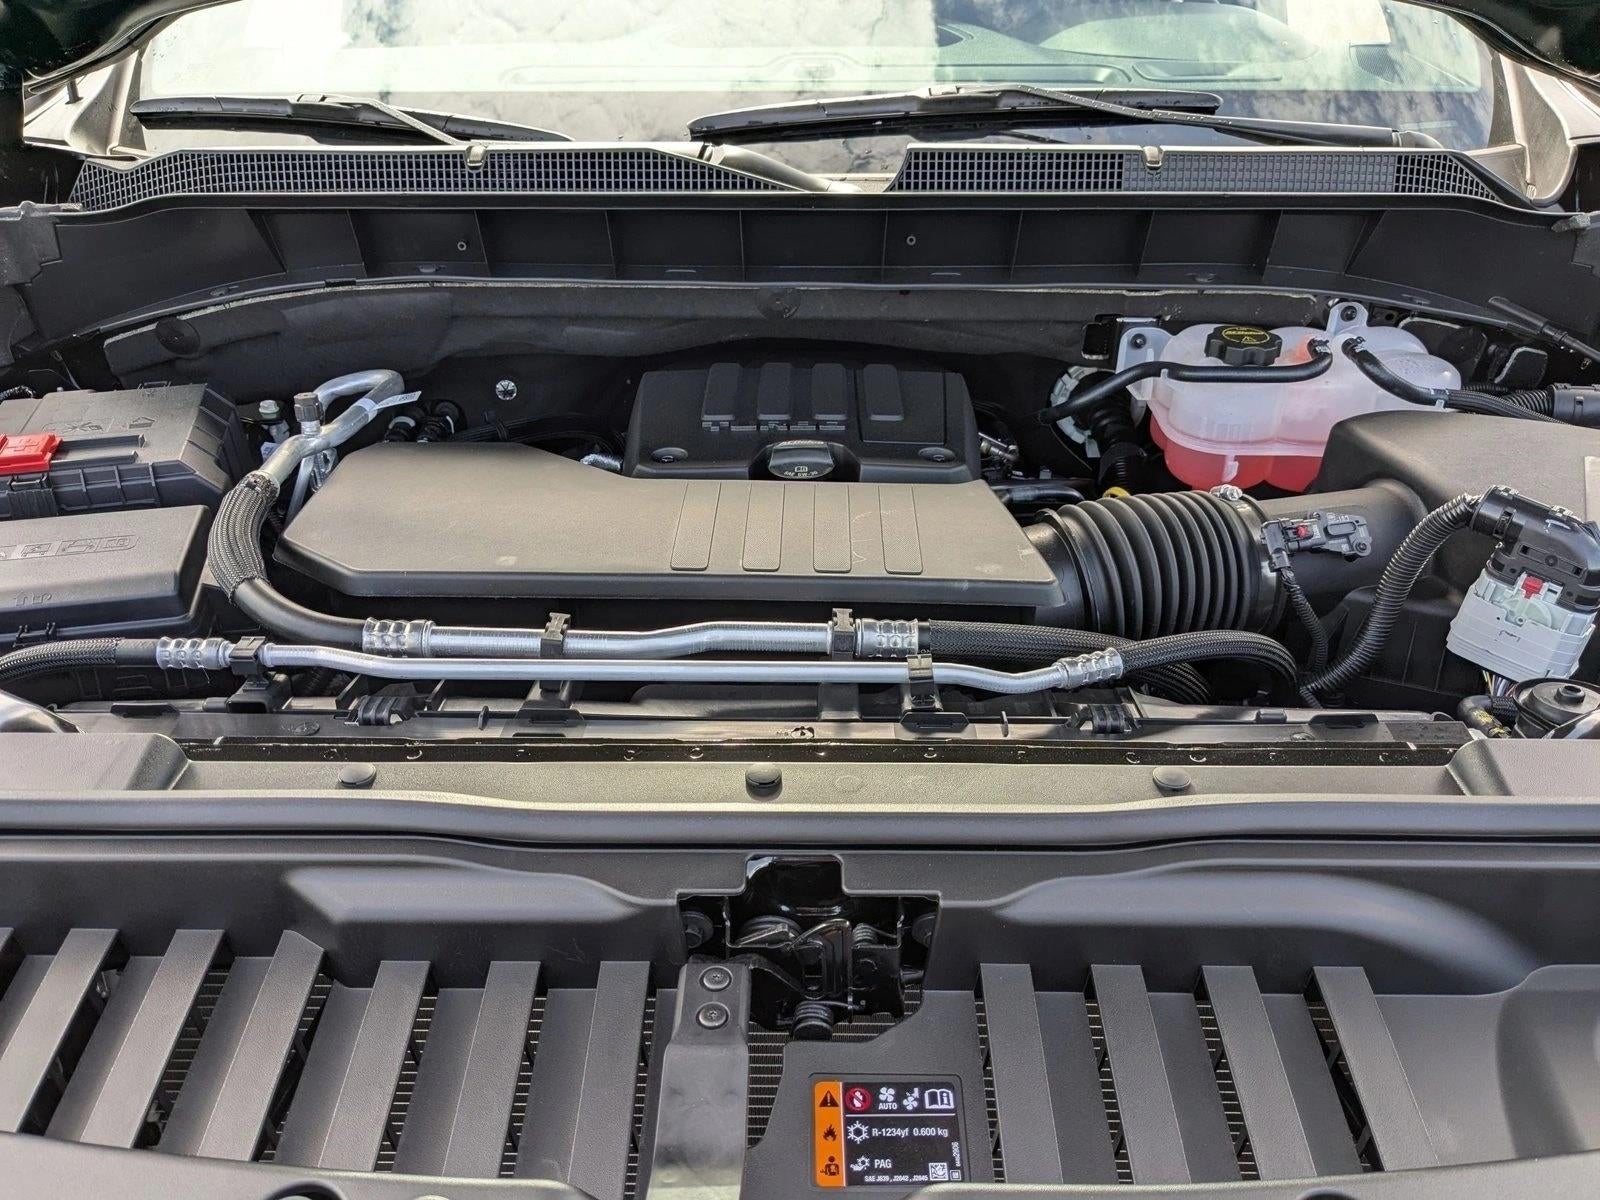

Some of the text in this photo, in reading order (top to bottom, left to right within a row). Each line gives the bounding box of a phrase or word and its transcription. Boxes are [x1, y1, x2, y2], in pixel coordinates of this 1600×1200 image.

[878, 1102, 898, 1110] AUTO
[872, 1127, 948, 1138] R-1234yf 0.600 kg
[874, 1159, 892, 1169] PAG
